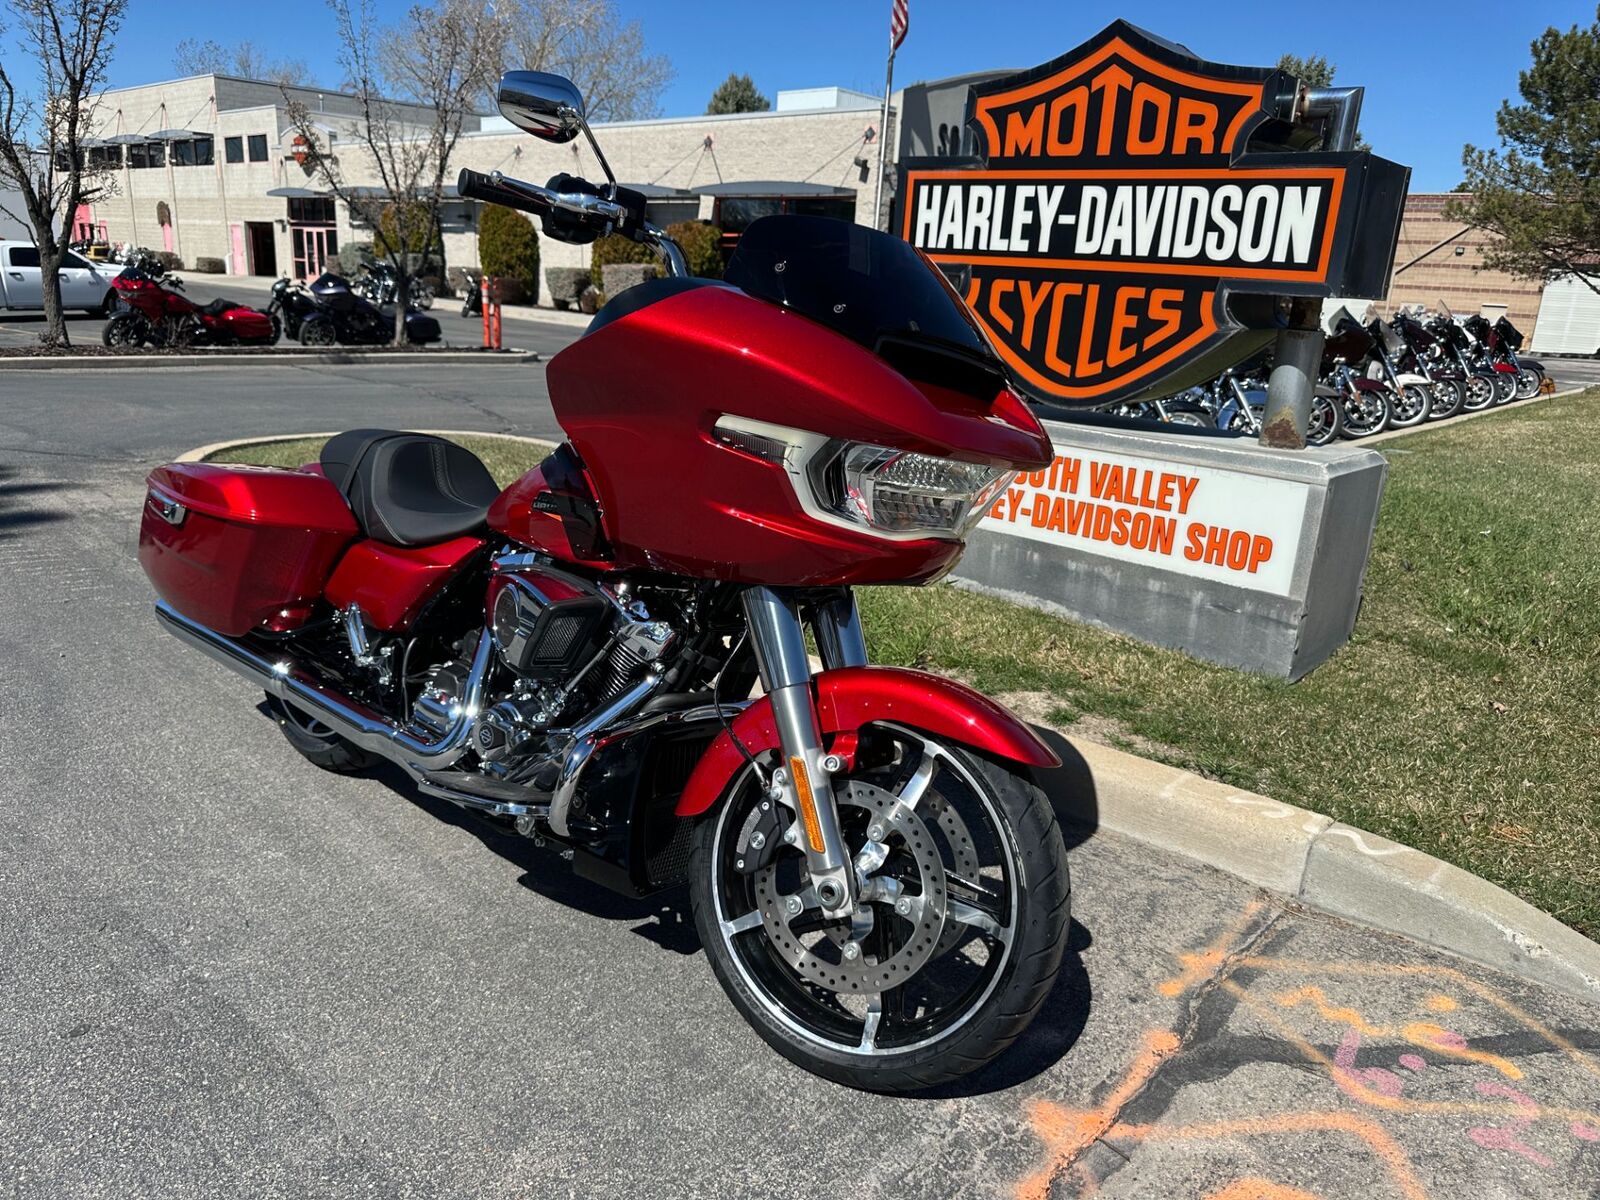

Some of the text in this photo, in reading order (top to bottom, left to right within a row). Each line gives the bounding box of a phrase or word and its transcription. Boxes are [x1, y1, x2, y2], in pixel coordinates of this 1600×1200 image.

[1004, 64, 1219, 157] MOTOR
[915, 184, 1322, 264] HARLEY-DAVIDSON
[989, 279, 1185, 378] CYCLES
[1013, 455, 1198, 514] UTH VALLEY
[984, 488, 1273, 573] EY-DAVIDSON SHOP
